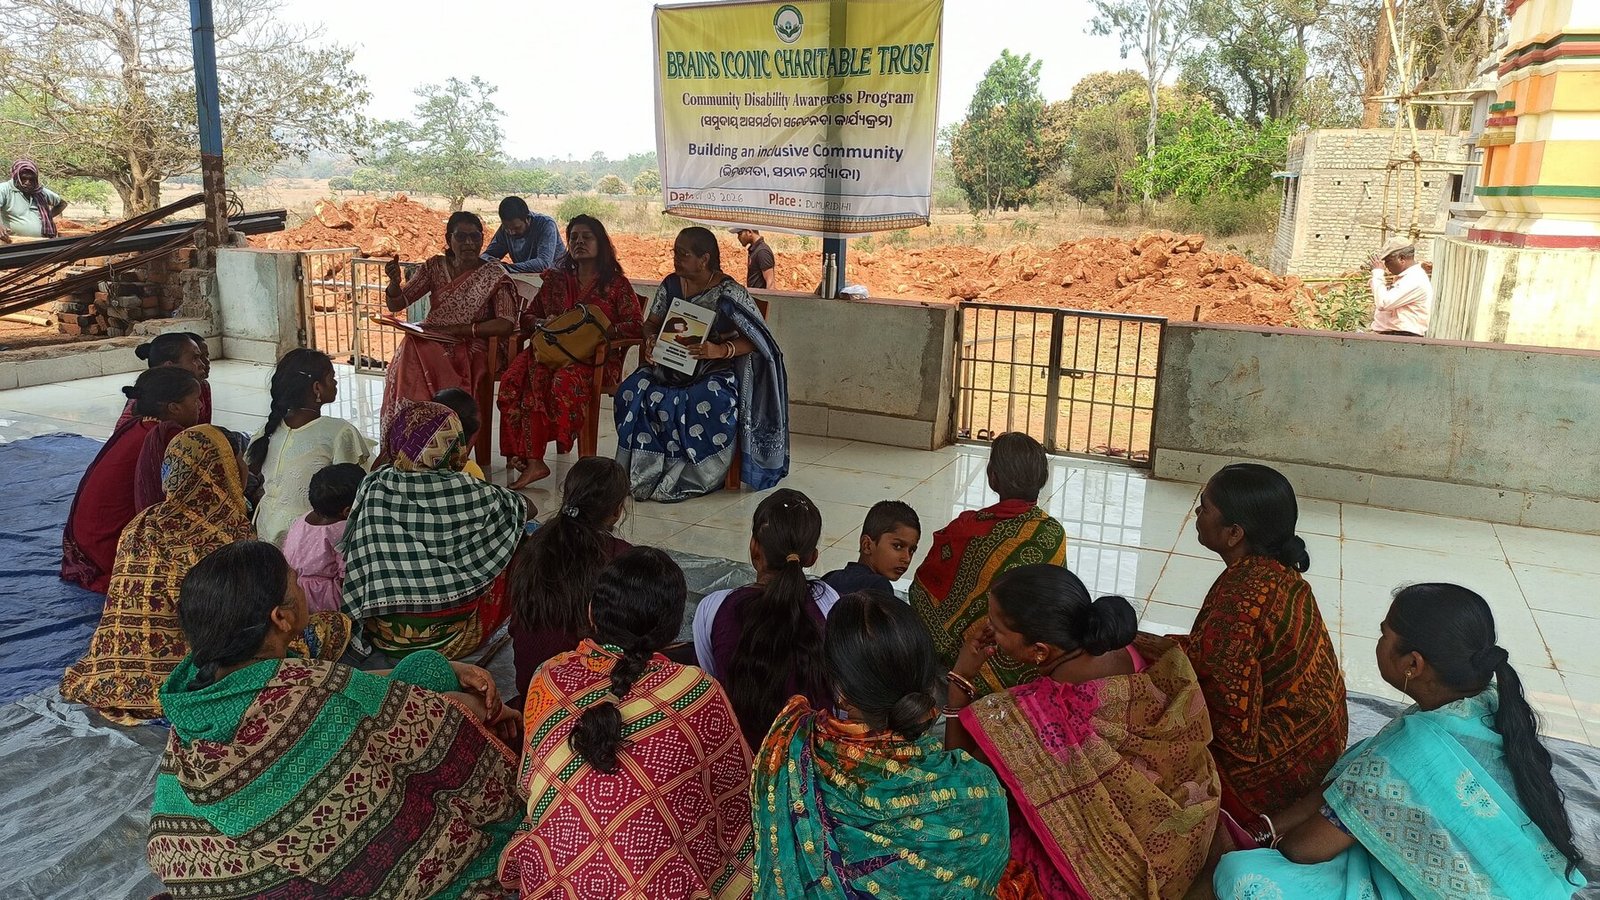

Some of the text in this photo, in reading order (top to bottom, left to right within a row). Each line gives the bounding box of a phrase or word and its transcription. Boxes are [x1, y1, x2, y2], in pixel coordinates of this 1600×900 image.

[667, 43, 934, 79] BRAINS ICONIC CHARITABLE TRUST
[682, 92, 741, 110] Community
[744, 92, 790, 110] Disability
[857, 90, 914, 108] Program
[688, 143, 904, 162] Building an inclusive Community
[769, 193, 796, 206] Place
